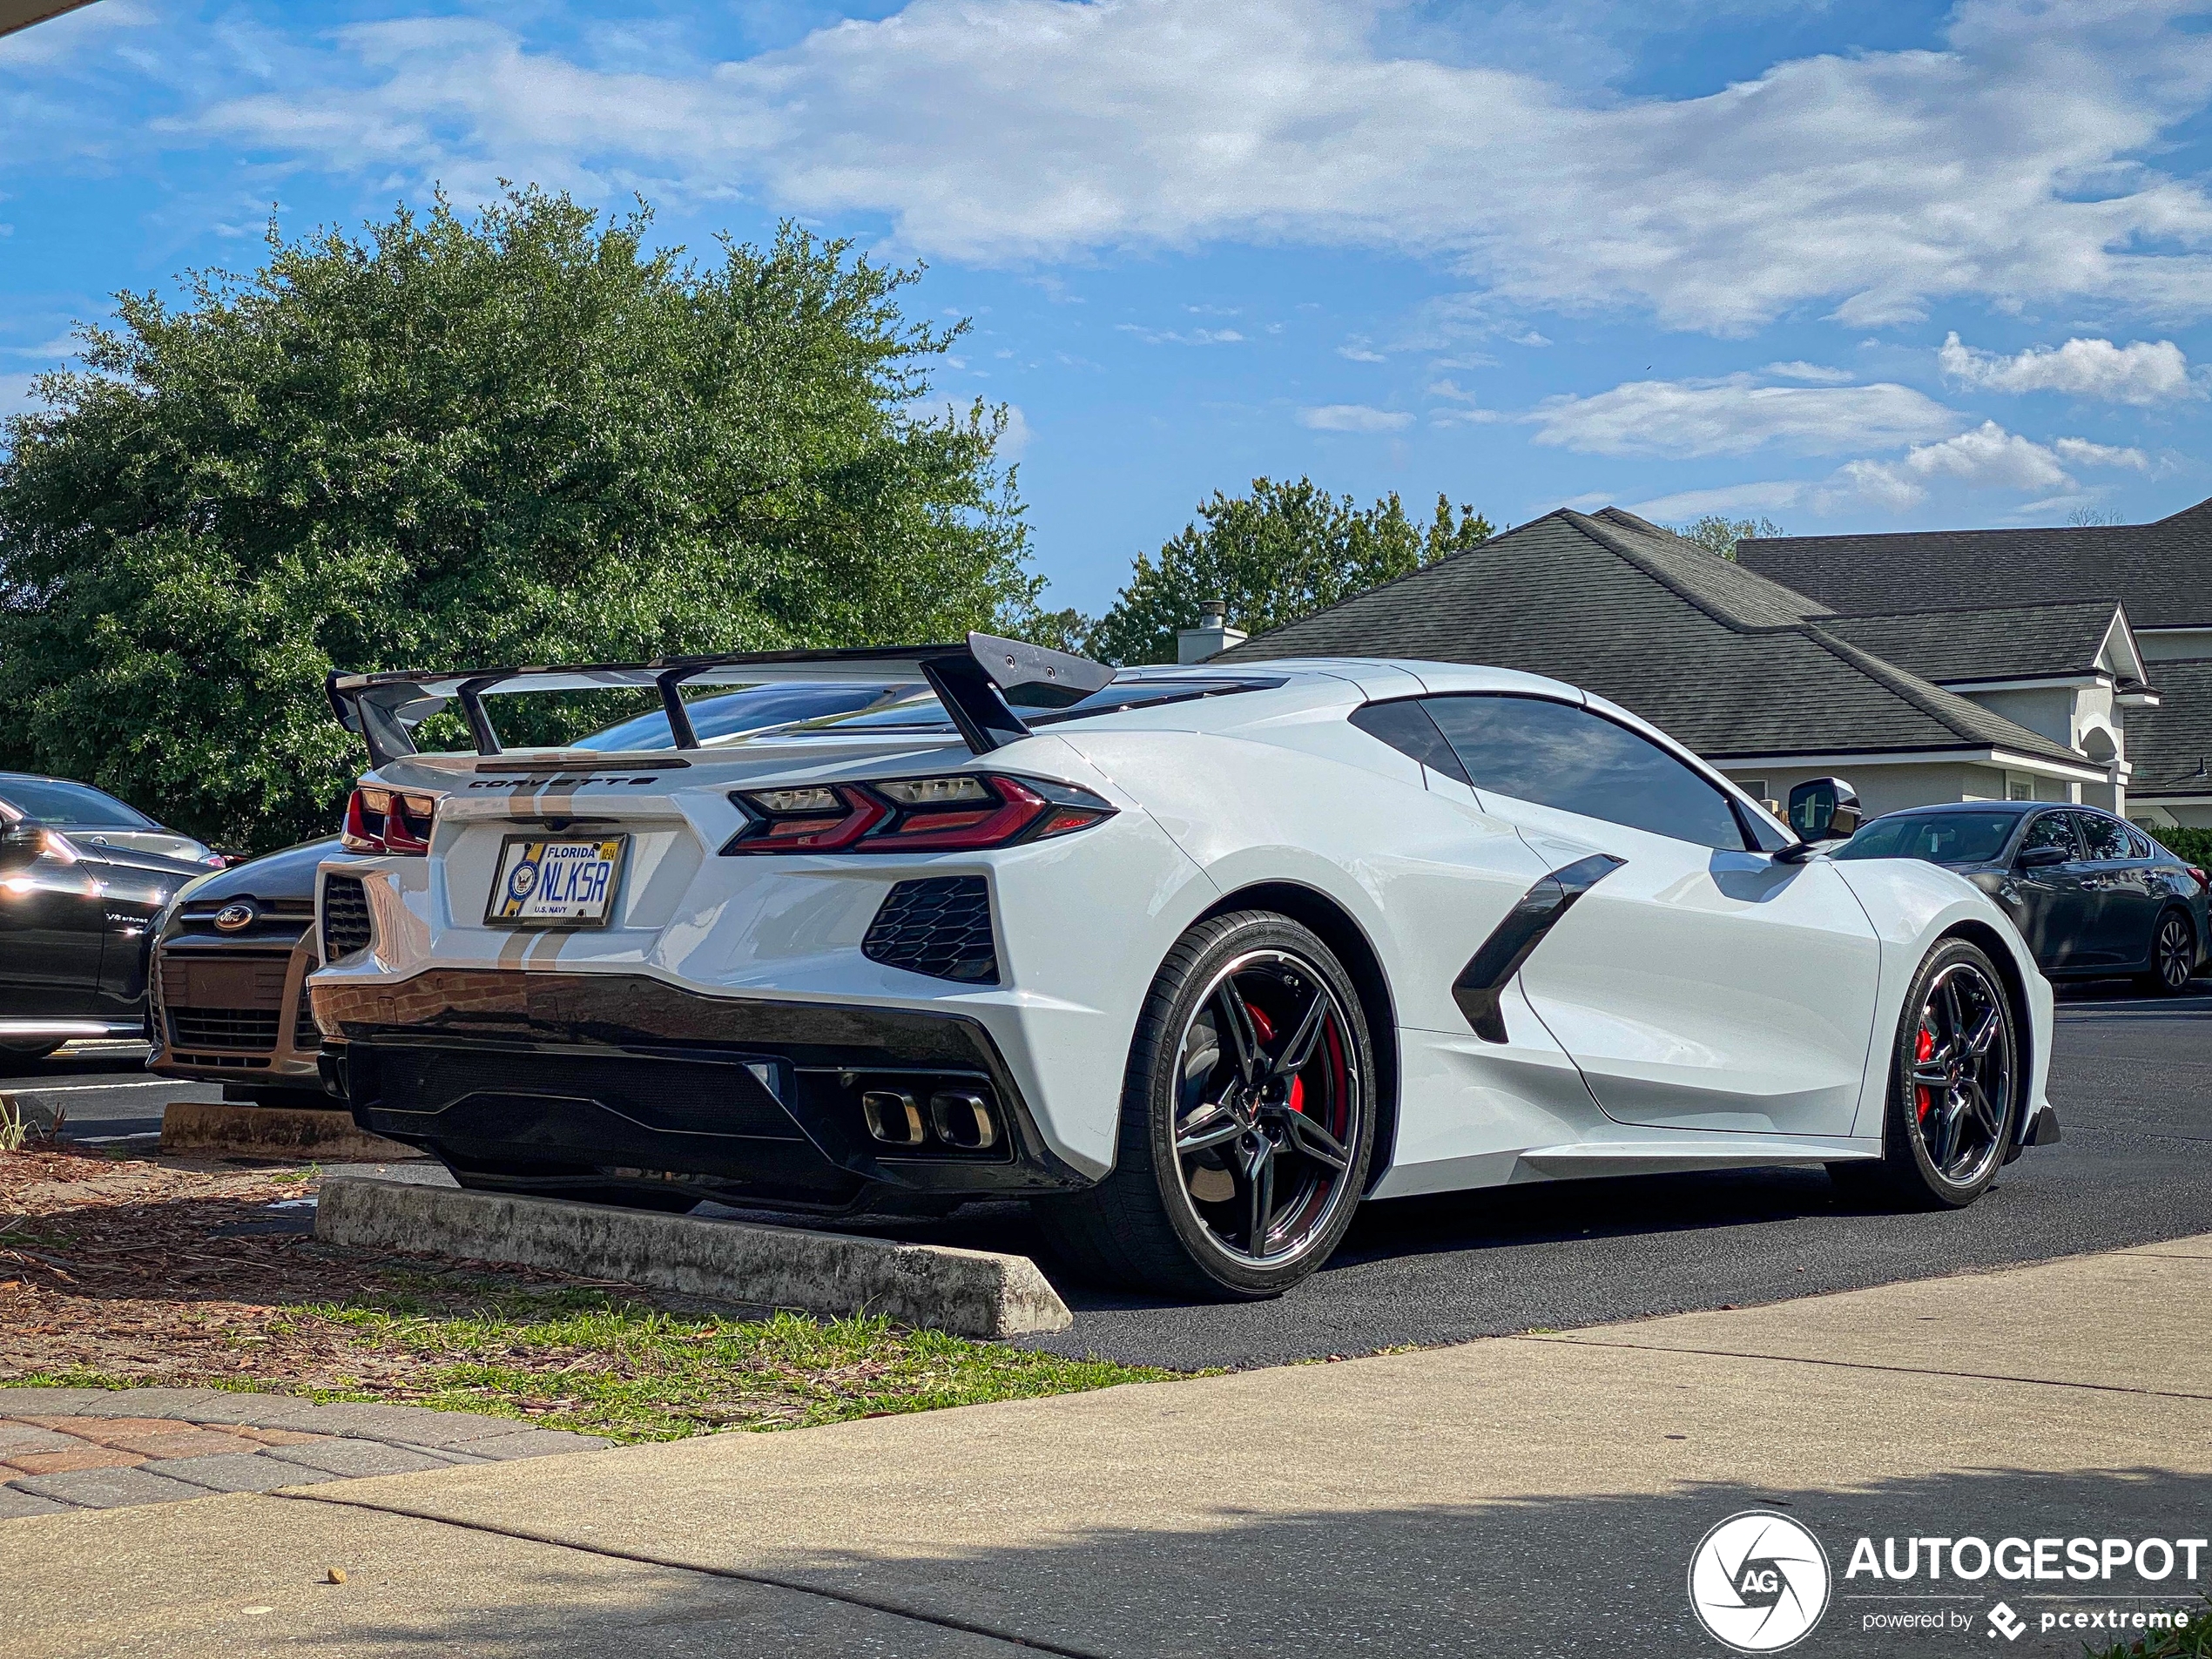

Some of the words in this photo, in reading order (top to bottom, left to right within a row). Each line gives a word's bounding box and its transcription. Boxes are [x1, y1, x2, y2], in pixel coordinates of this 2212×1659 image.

[469, 777, 659, 789] CORVETTE
[547, 847, 596, 859] FLORIDA
[538, 861, 610, 902] NLKSR
[218, 907, 243, 922] Ford
